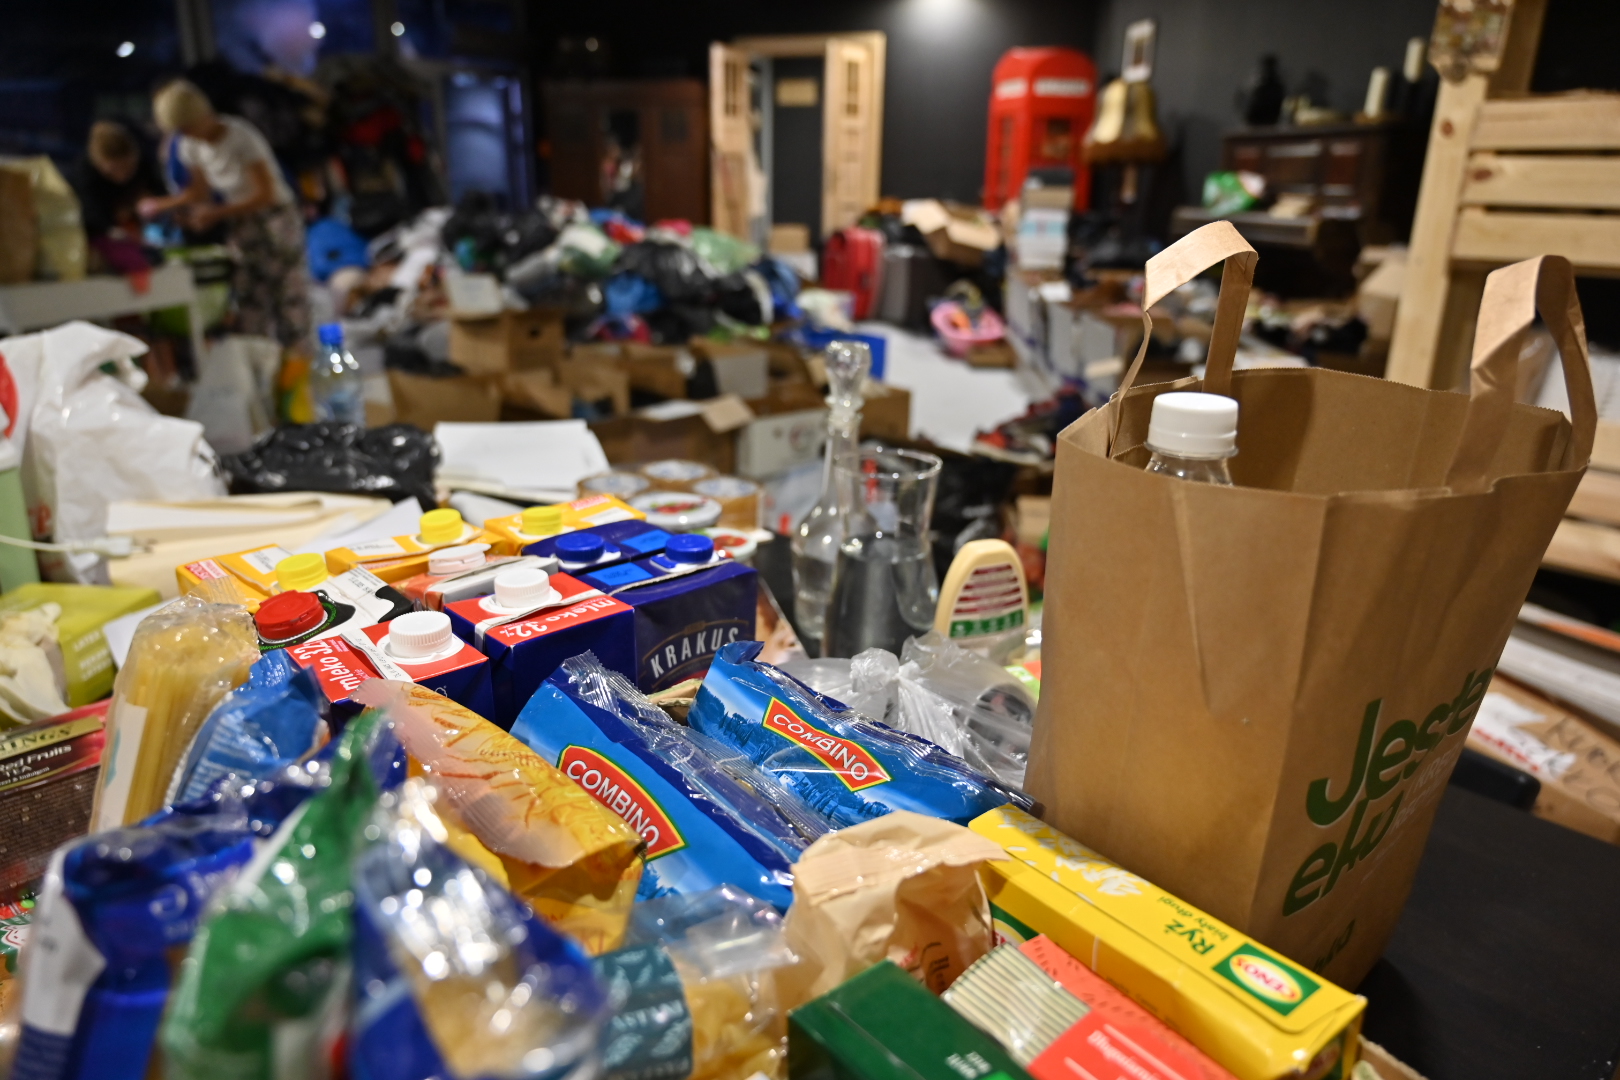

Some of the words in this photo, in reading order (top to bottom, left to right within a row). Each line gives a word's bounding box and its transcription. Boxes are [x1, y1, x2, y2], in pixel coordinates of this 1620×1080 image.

[545, 598, 617, 622] mleko
[650, 627, 739, 679] KRAKUS
[319, 656, 363, 691] mleko
[27, 744, 72, 764] Fruits
[772, 713, 869, 781] COMBINO
[566, 760, 660, 848] COMBINO
[1164, 919, 1216, 955] Ryż
[1235, 955, 1298, 999] CENOS
